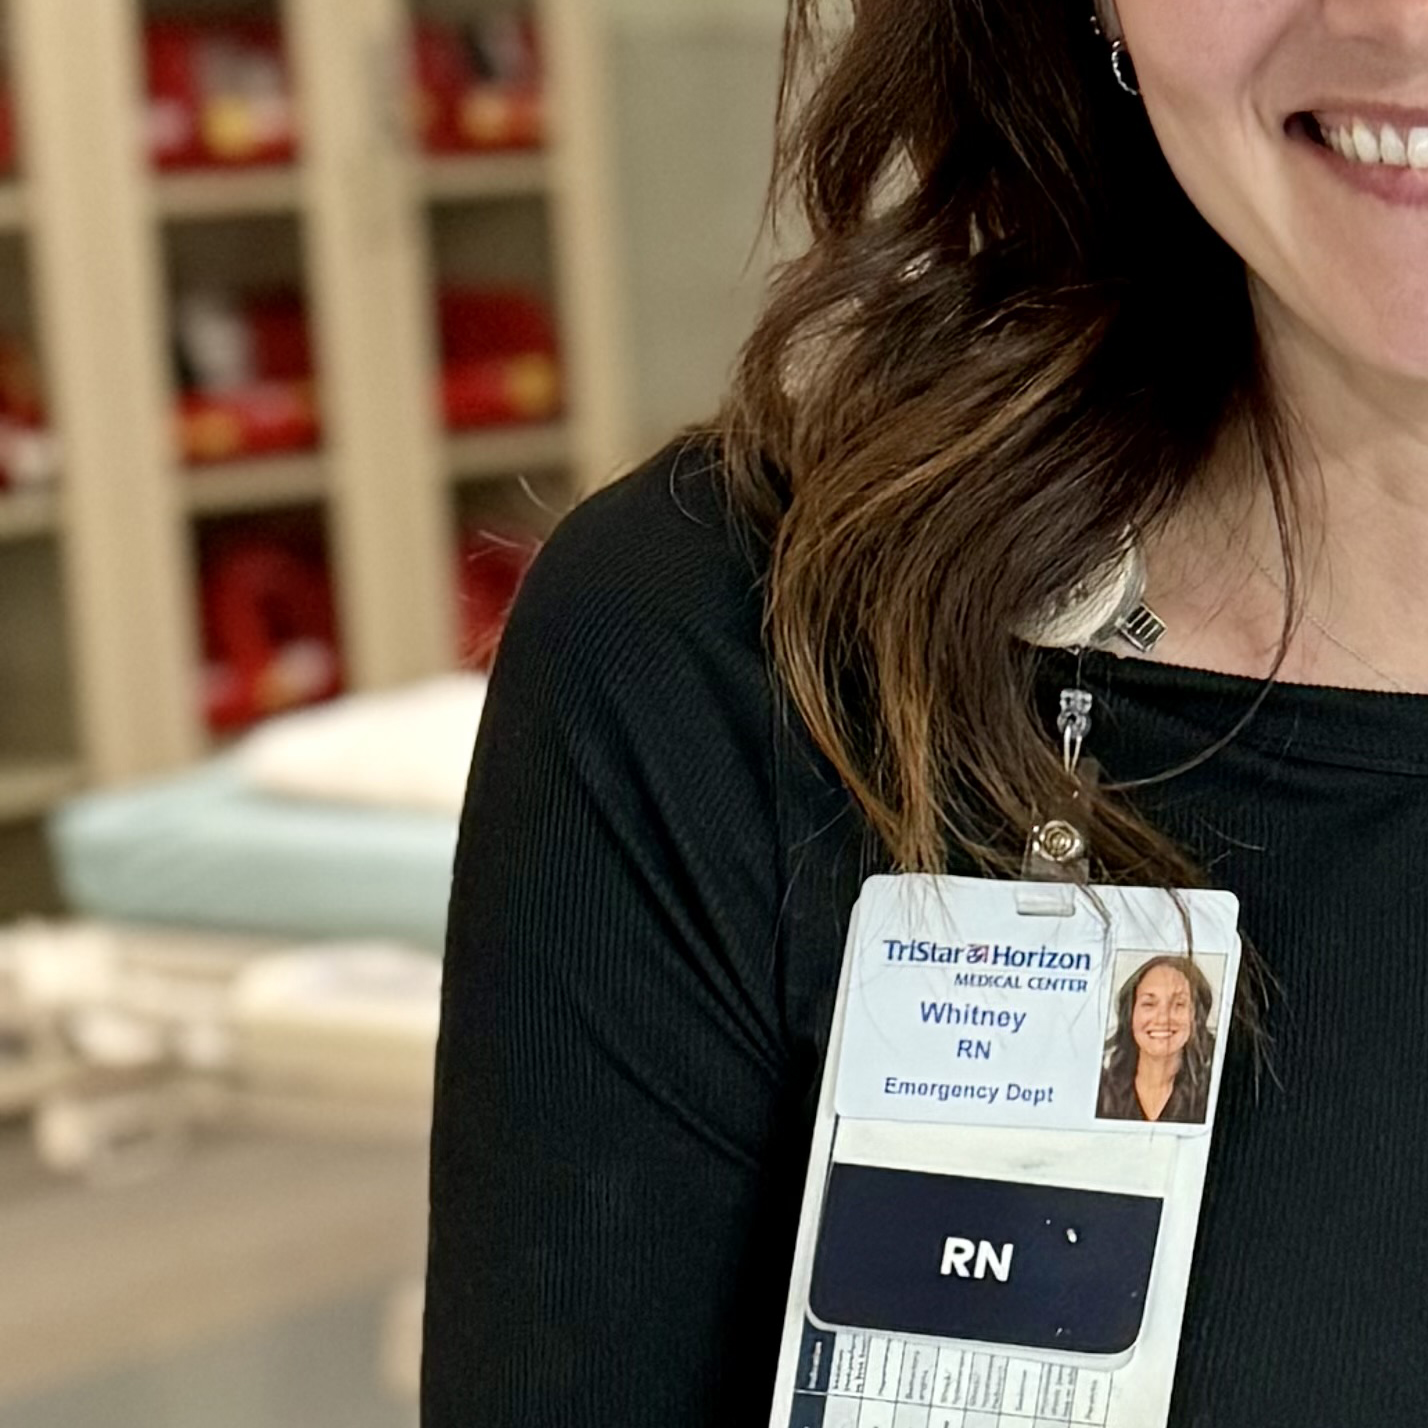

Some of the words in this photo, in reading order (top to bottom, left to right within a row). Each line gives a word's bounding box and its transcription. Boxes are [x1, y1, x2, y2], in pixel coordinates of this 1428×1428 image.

[883, 938, 965, 964] TriStar
[992, 944, 1091, 971] Horizon
[954, 972, 1022, 990] MEDICAL
[1027, 976, 1089, 993] CENTER
[920, 1000, 1027, 1034] Whitney
[956, 1038, 992, 1061] RN
[884, 1076, 1000, 1105] Emergency
[1006, 1082, 1054, 1106] Dept
[940, 1236, 1014, 1282] RN
